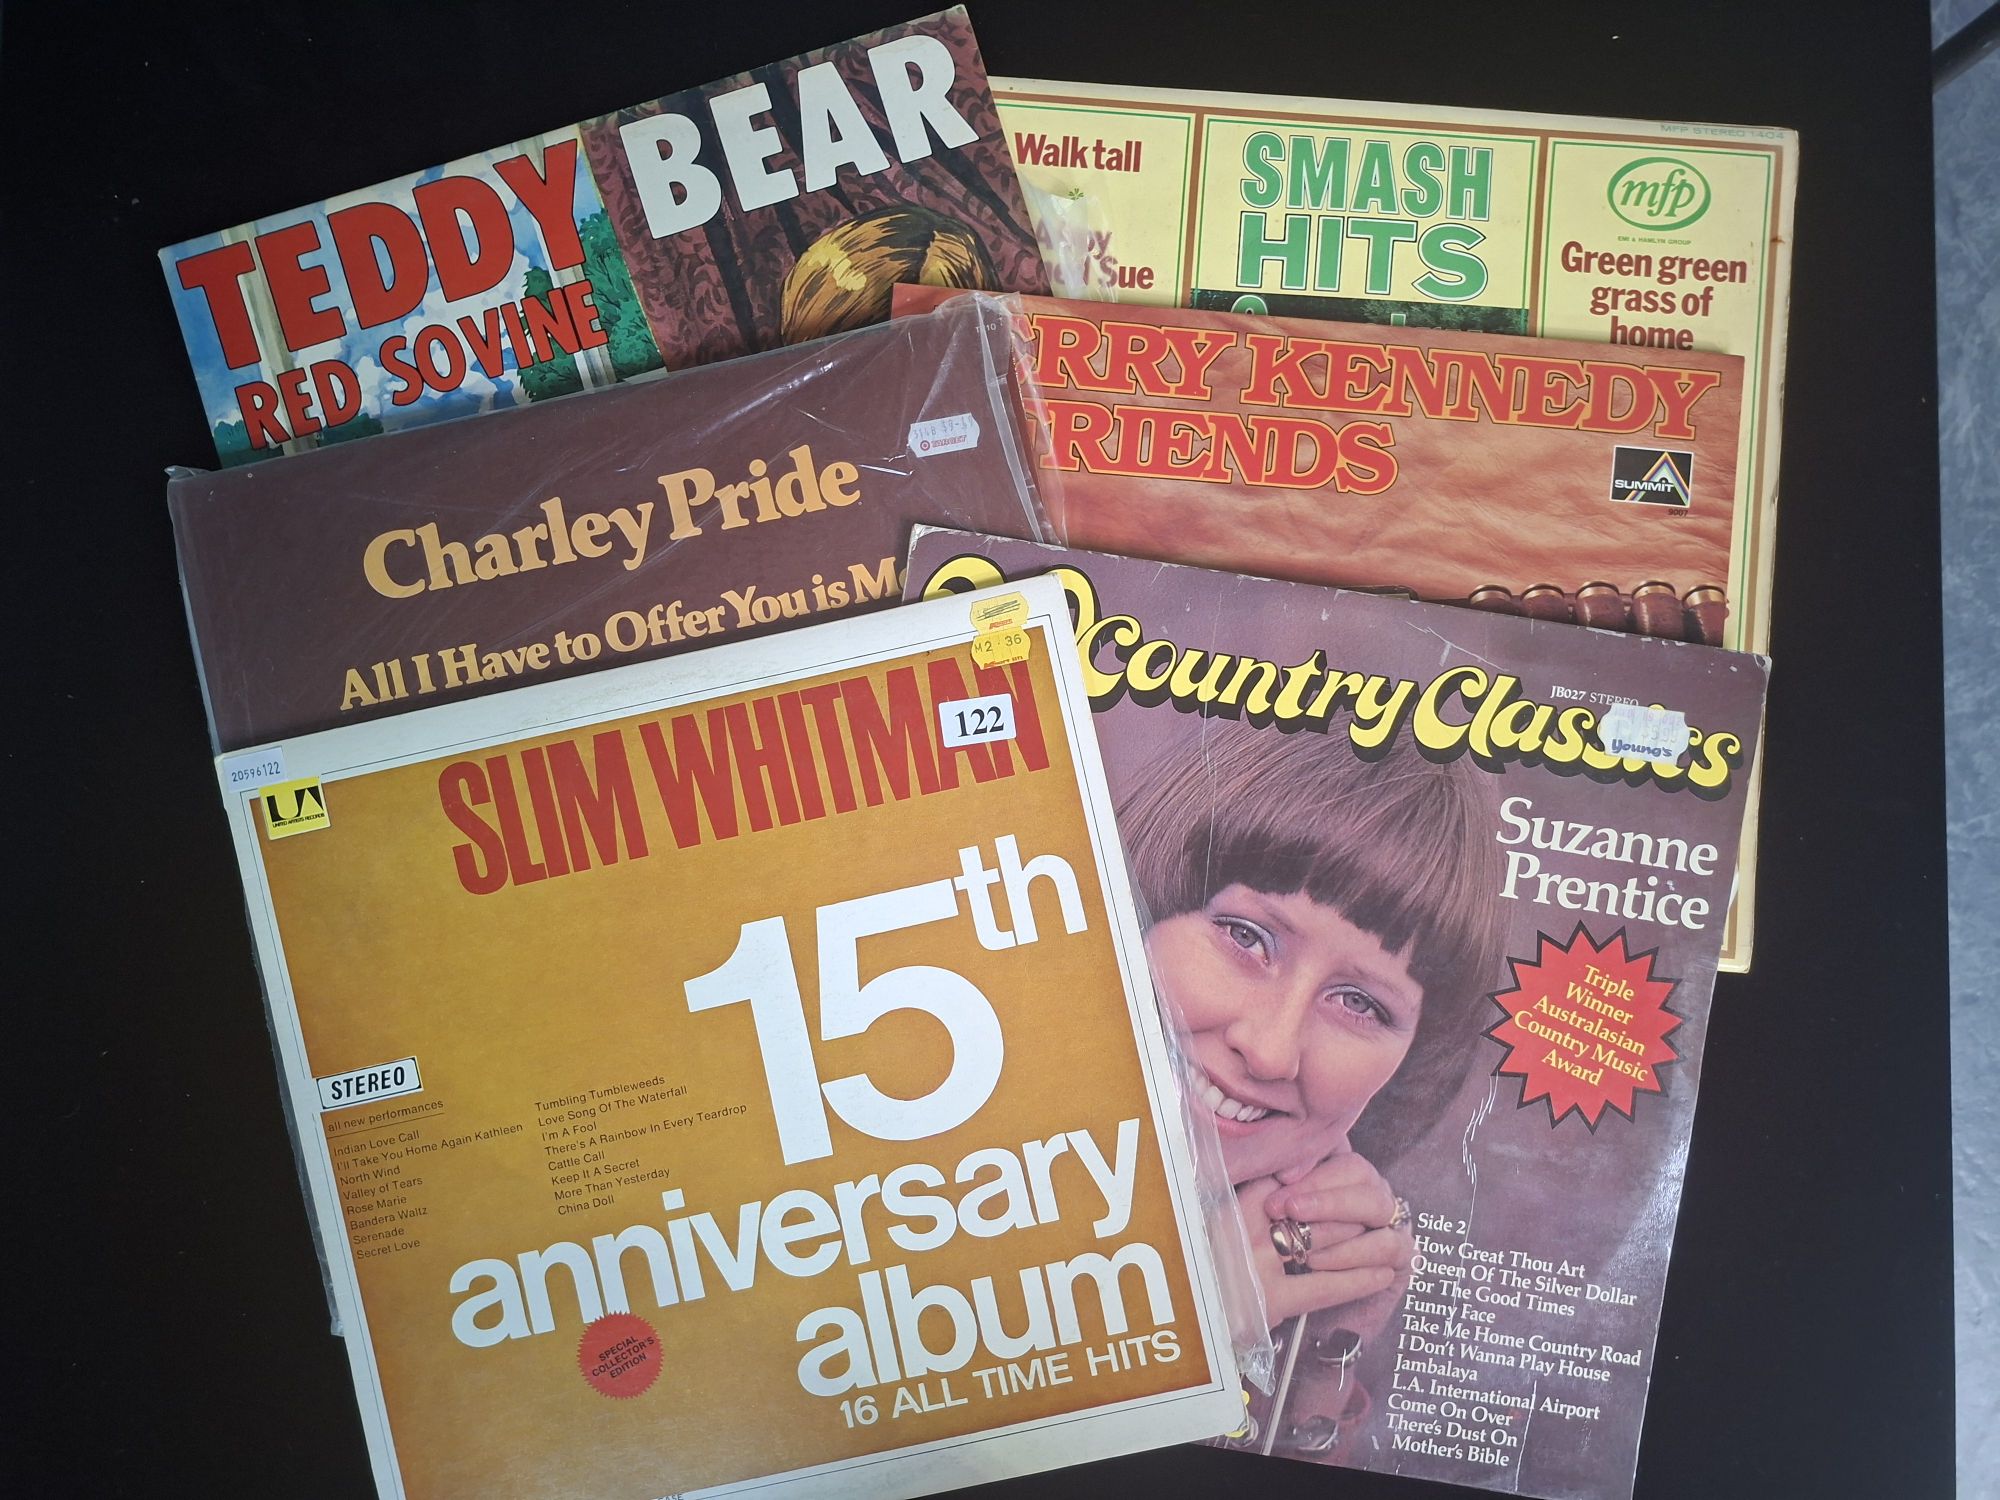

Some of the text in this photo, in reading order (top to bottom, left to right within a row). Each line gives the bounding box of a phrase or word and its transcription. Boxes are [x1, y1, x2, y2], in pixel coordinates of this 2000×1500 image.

[1693, 127, 1745, 137] STEREO
[1014, 132, 1142, 172] Walk tall
[1240, 131, 1493, 222] SMASH
[1620, 168, 1696, 218] mfp
[176, 35, 980, 370] TEDDY BEAR
[1099, 256, 1154, 289] Sue
[1236, 211, 1488, 301] HITS
[1561, 241, 1747, 286] Green green
[1590, 286, 1714, 316] grass of
[1610, 316, 1693, 350] home
[235, 280, 608, 449] RED SOVINE
[1241, 334, 1721, 440] KENNEDY
[363, 445, 862, 598] Charley Pride
[1667, 508, 1688, 517] 9007
[339, 573, 848, 711] All I Have to Offer You is
[1076, 613, 1741, 788] Country Class
[1550, 685, 1586, 700] JB027
[954, 705, 1005, 737] 122
[1611, 739, 1673, 757] Young's
[231, 761, 281, 782] 20596122
[438, 656, 1050, 895] SLIM WHITMAN
[1496, 796, 1718, 930] Suzanne Prentice
[1584, 964, 1635, 1001] Triple
[1566, 982, 1633, 1025] Winner
[1533, 995, 1645, 1057] Australasian
[1514, 1010, 1648, 1082] Country Music
[331, 1066, 405, 1100] STEREO
[1541, 1049, 1604, 1087] Award
[535, 1076, 665, 1112] Tumbling Tumbleweeds
[538, 1085, 688, 1127] Love Song Of The Waterfall
[327, 1100, 444, 1133] all new performances
[541, 1121, 597, 1142] I'm A Fool
[544, 1103, 747, 1156] There's A Rainbow In Every Teardrop
[333, 1130, 420, 1157] Indian Love Call
[336, 1123, 523, 1172] I'll Take You Home Again Kathleen
[548, 1150, 605, 1171] Cattle Call
[340, 1166, 401, 1187] North Wind
[342, 1176, 423, 1201] Valley of Tears
[551, 1158, 640, 1186] Keep It A Secret
[554, 1167, 670, 1201] More Than Yesterday
[347, 1195, 407, 1216] Rose Marie
[350, 1206, 428, 1231] Bandera Waltz
[557, 1194, 615, 1216] China Doll
[353, 1227, 405, 1245] Serenade
[449, 1118, 1140, 1347] anniversary
[1417, 1213, 1466, 1235] Side 2
[356, 1239, 421, 1260] Secret Love
[1414, 1235, 1586, 1279] How Great Thou Art
[1407, 1275, 1575, 1317] For The Good Times
[1410, 1255, 1638, 1306] Queen Of The Silver Dollar
[796, 1242, 1176, 1397] album
[1404, 1294, 1496, 1324] Funny Face
[592, 1336, 655, 1377] COLLECTOR'S
[598, 1336, 638, 1362] SPECIAL
[1398, 1333, 1611, 1382] I Don't Wanna Play House
[1402, 1314, 1642, 1367] Take Me Home Country Road
[609, 1352, 647, 1379] EDITION
[839, 1330, 1181, 1429] 16 ALL TIME HITS
[1394, 1353, 1478, 1383] Jambalaya
[1387, 1393, 1514, 1427] Come On Over
[1391, 1373, 1601, 1420] L.A. International Airport
[1385, 1412, 1518, 1448] There's Dust On
[1391, 1434, 1510, 1467] Mother's Bible
